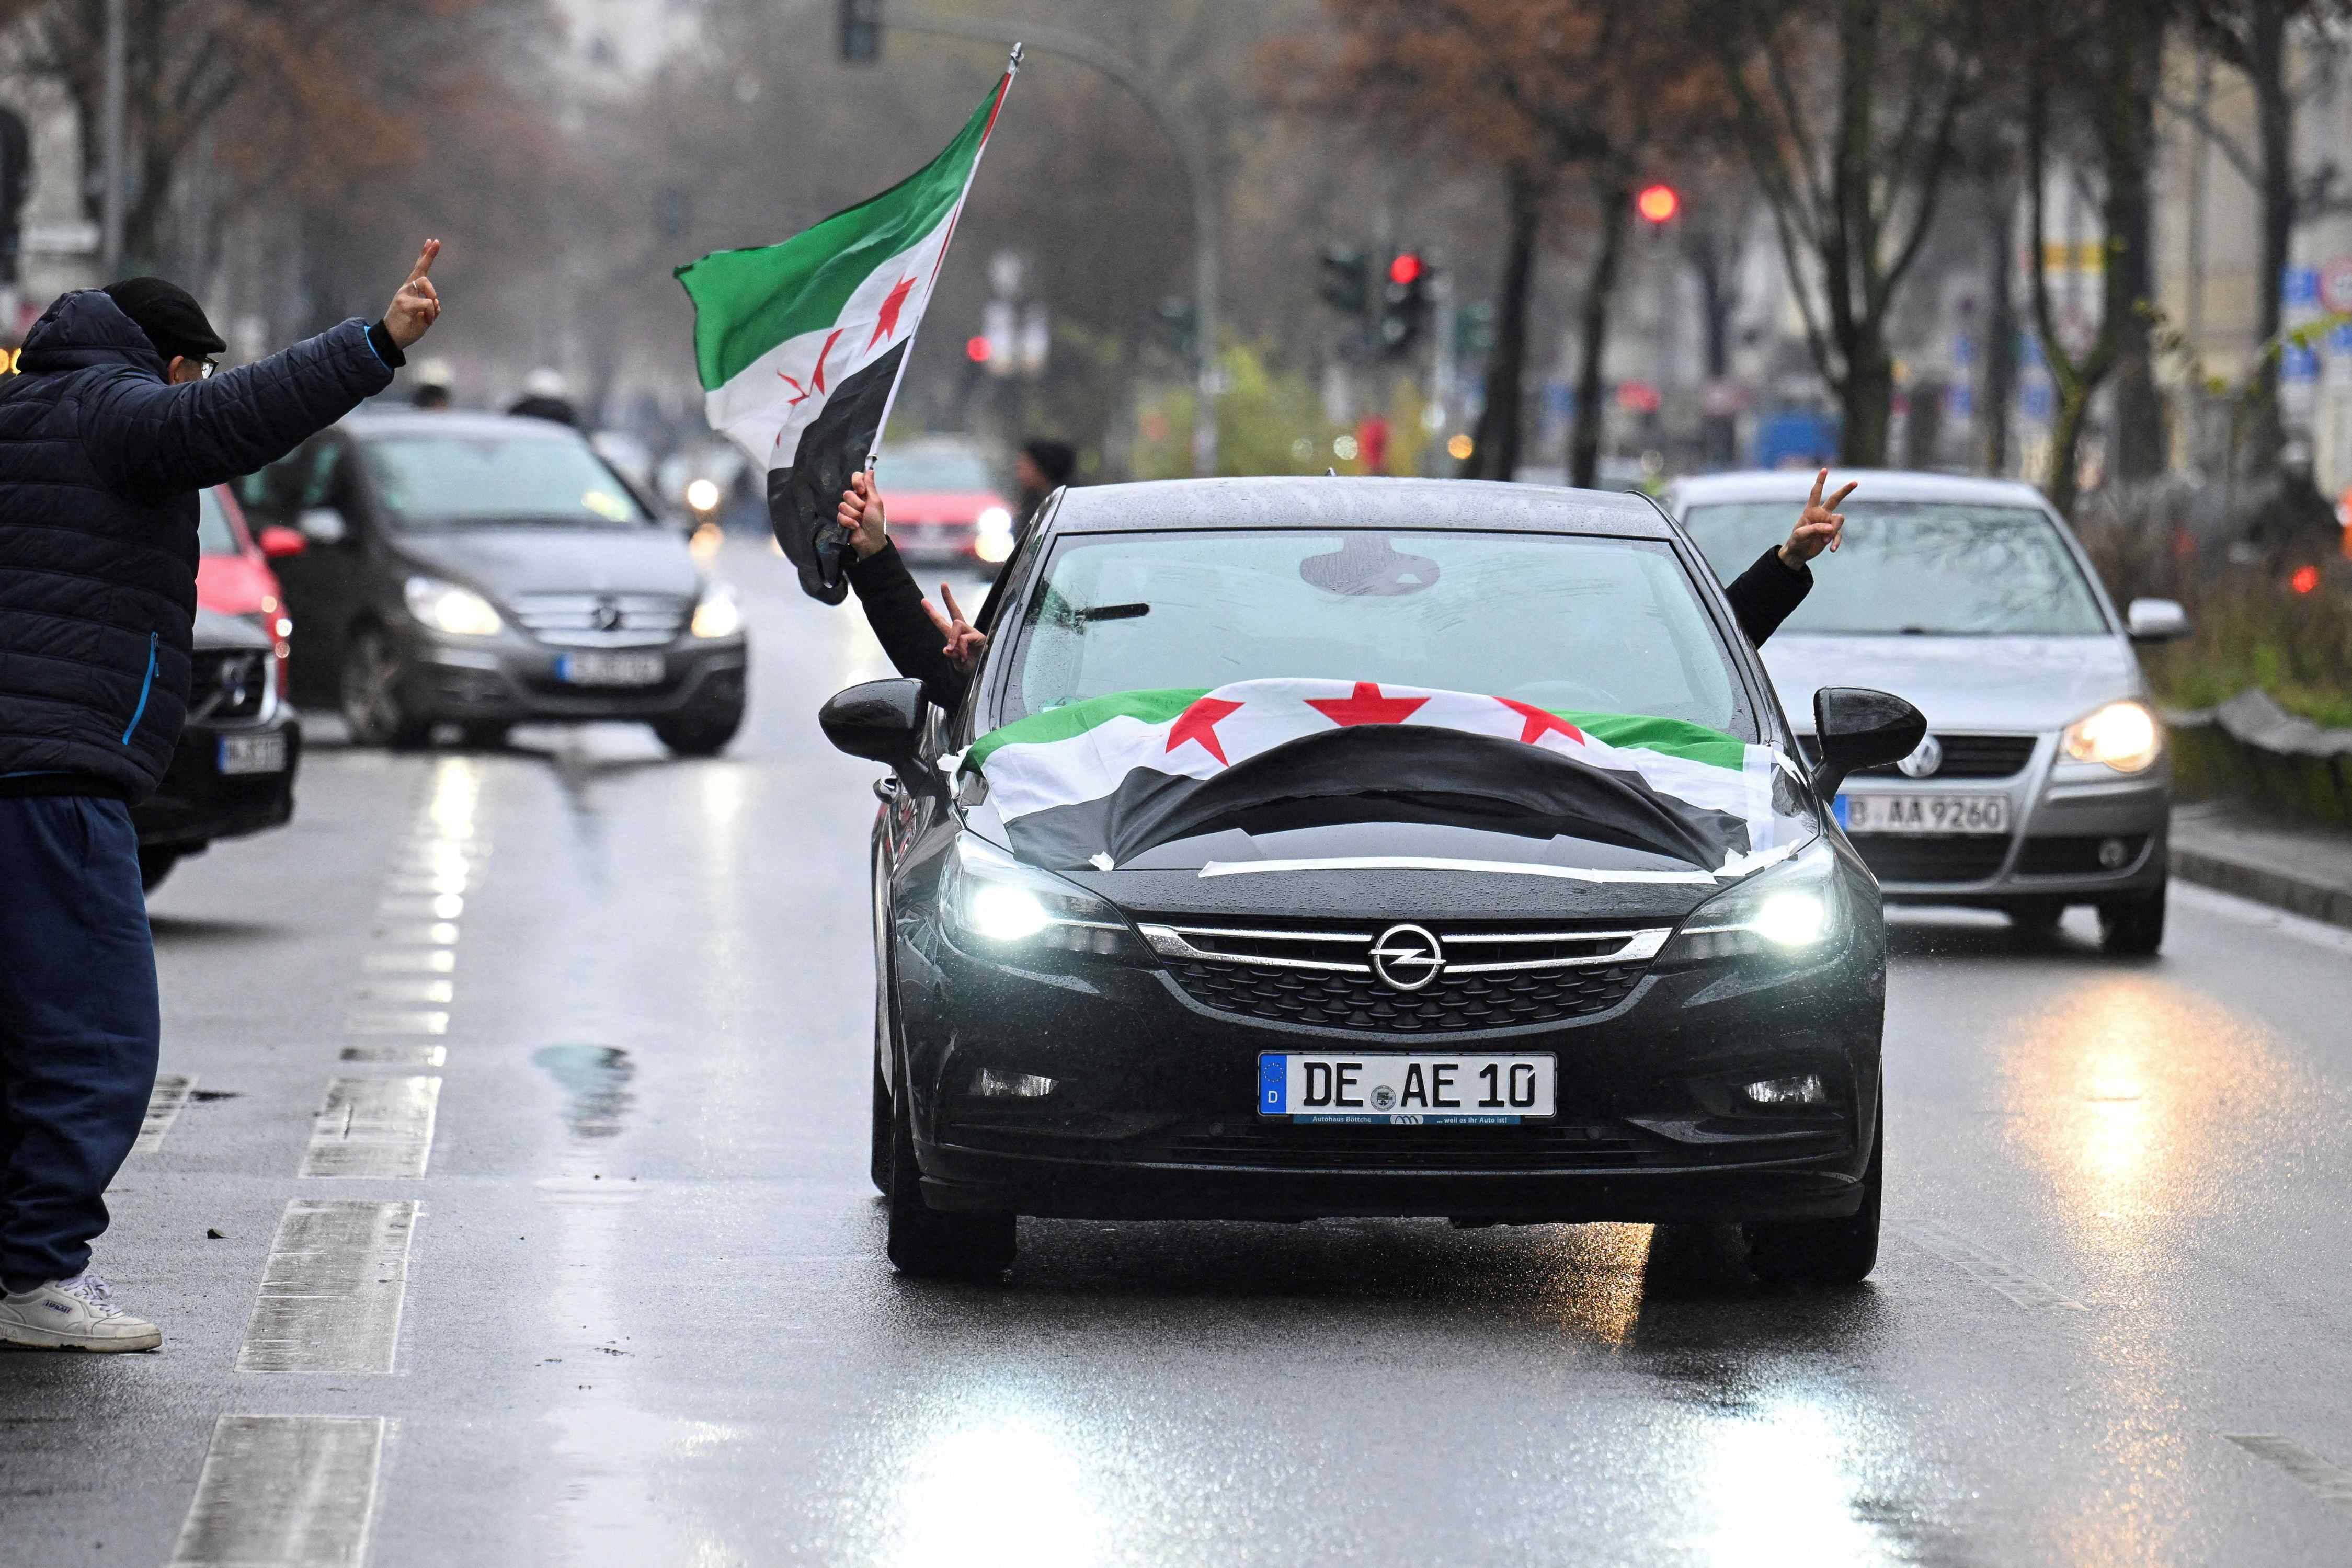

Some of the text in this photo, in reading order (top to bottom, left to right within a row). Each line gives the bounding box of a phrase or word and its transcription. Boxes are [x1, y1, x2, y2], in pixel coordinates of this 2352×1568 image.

[1850, 801, 2000, 826] B AA 9260
[1268, 1091, 1278, 1103] D
[1304, 1062, 1364, 1107] DE
[1401, 1063, 1460, 1107] AE
[1479, 1063, 1535, 1107] 10
